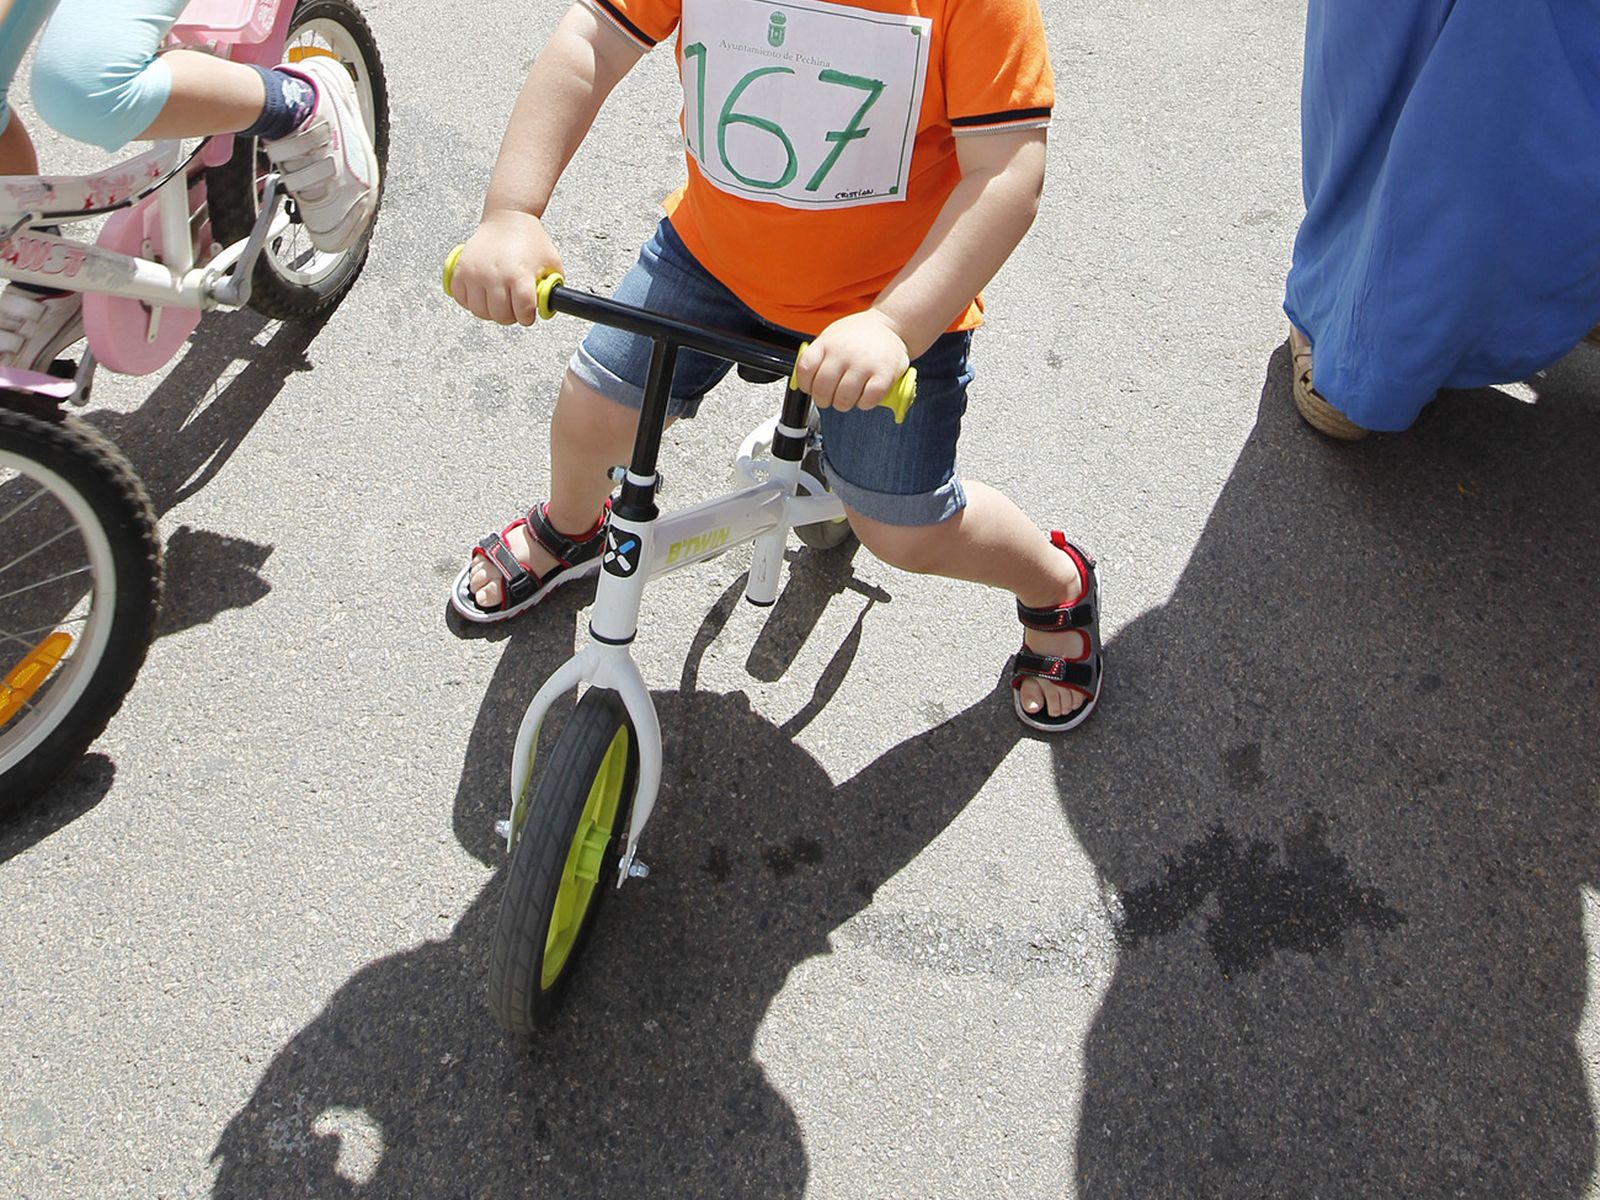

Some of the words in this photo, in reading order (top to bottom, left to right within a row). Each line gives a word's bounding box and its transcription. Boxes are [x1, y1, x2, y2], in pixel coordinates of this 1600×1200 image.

[719, 39, 782, 60] Ayuntamiento
[782, 52, 794, 61] de
[795, 53, 831, 68] Pechina
[684, 42, 887, 192] 167
